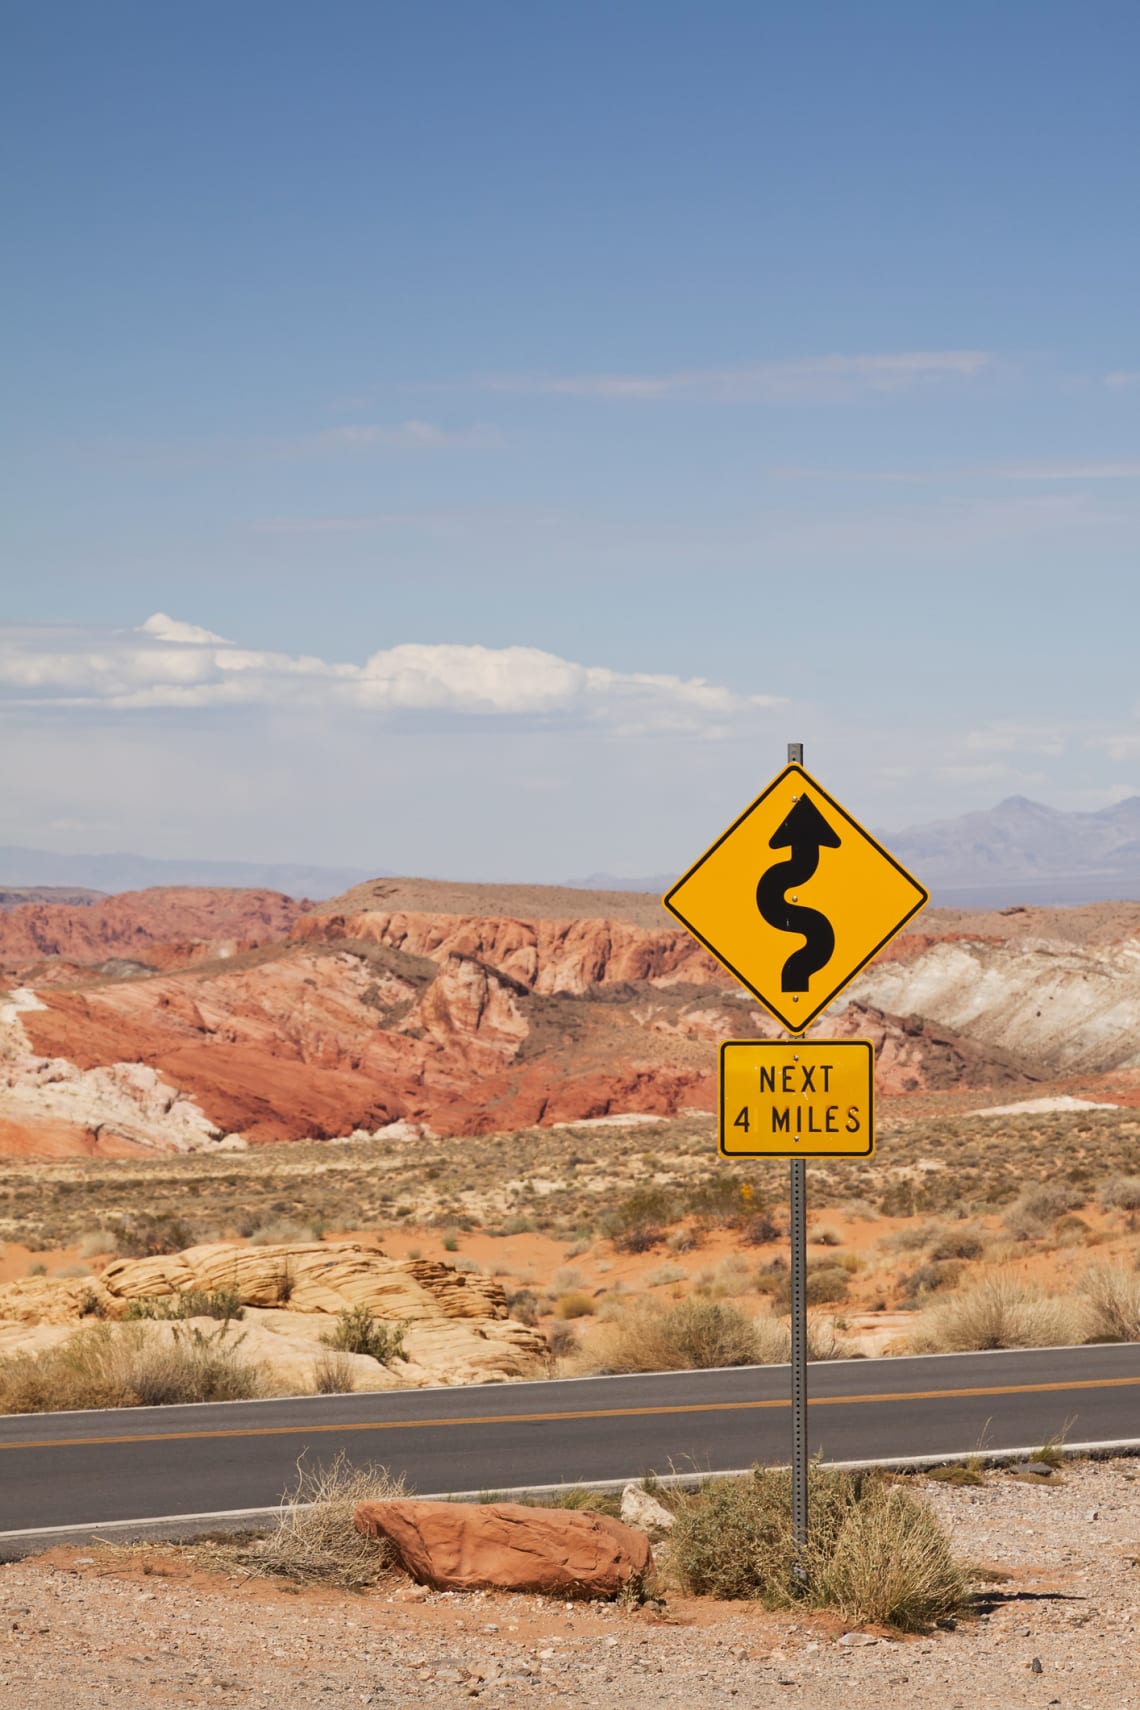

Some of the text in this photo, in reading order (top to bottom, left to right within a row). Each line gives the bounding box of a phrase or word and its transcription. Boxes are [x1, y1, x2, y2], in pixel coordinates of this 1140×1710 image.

[760, 1065, 834, 1093] NEXT
[733, 1105, 861, 1133] 4 MILES
